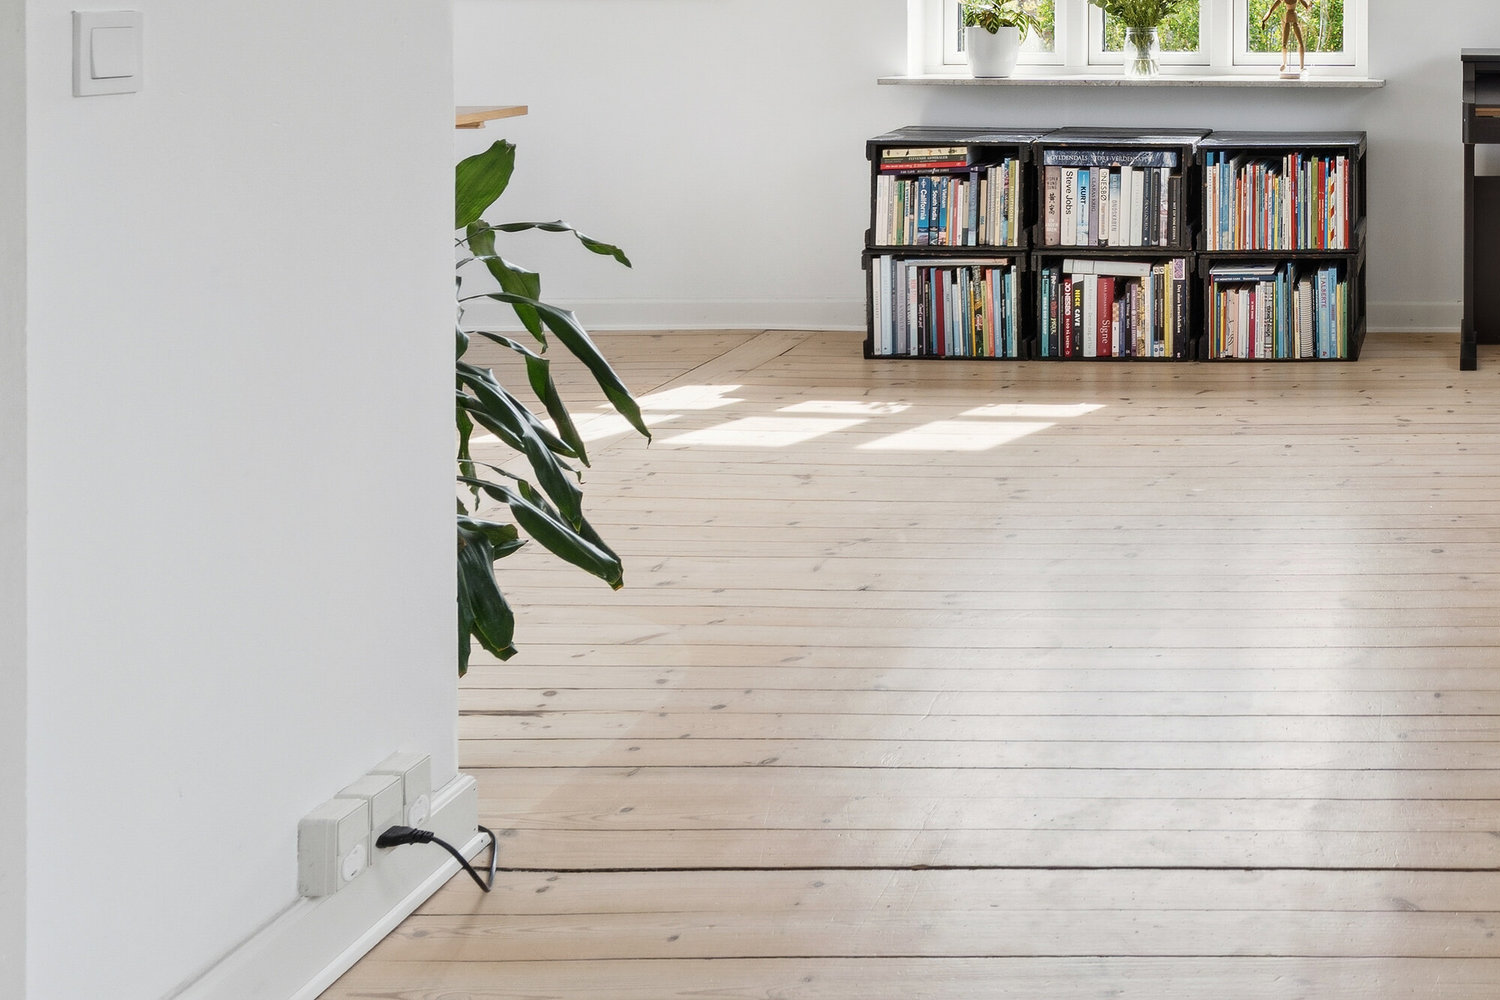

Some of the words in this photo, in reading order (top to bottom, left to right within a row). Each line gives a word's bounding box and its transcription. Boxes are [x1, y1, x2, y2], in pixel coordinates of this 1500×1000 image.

[1065, 171, 1074, 194] Steve
[920, 189, 928, 221] California
[1065, 195, 1074, 215] Jobs
[1064, 281, 1071, 292] JO
[1100, 319, 1111, 344] Signe
